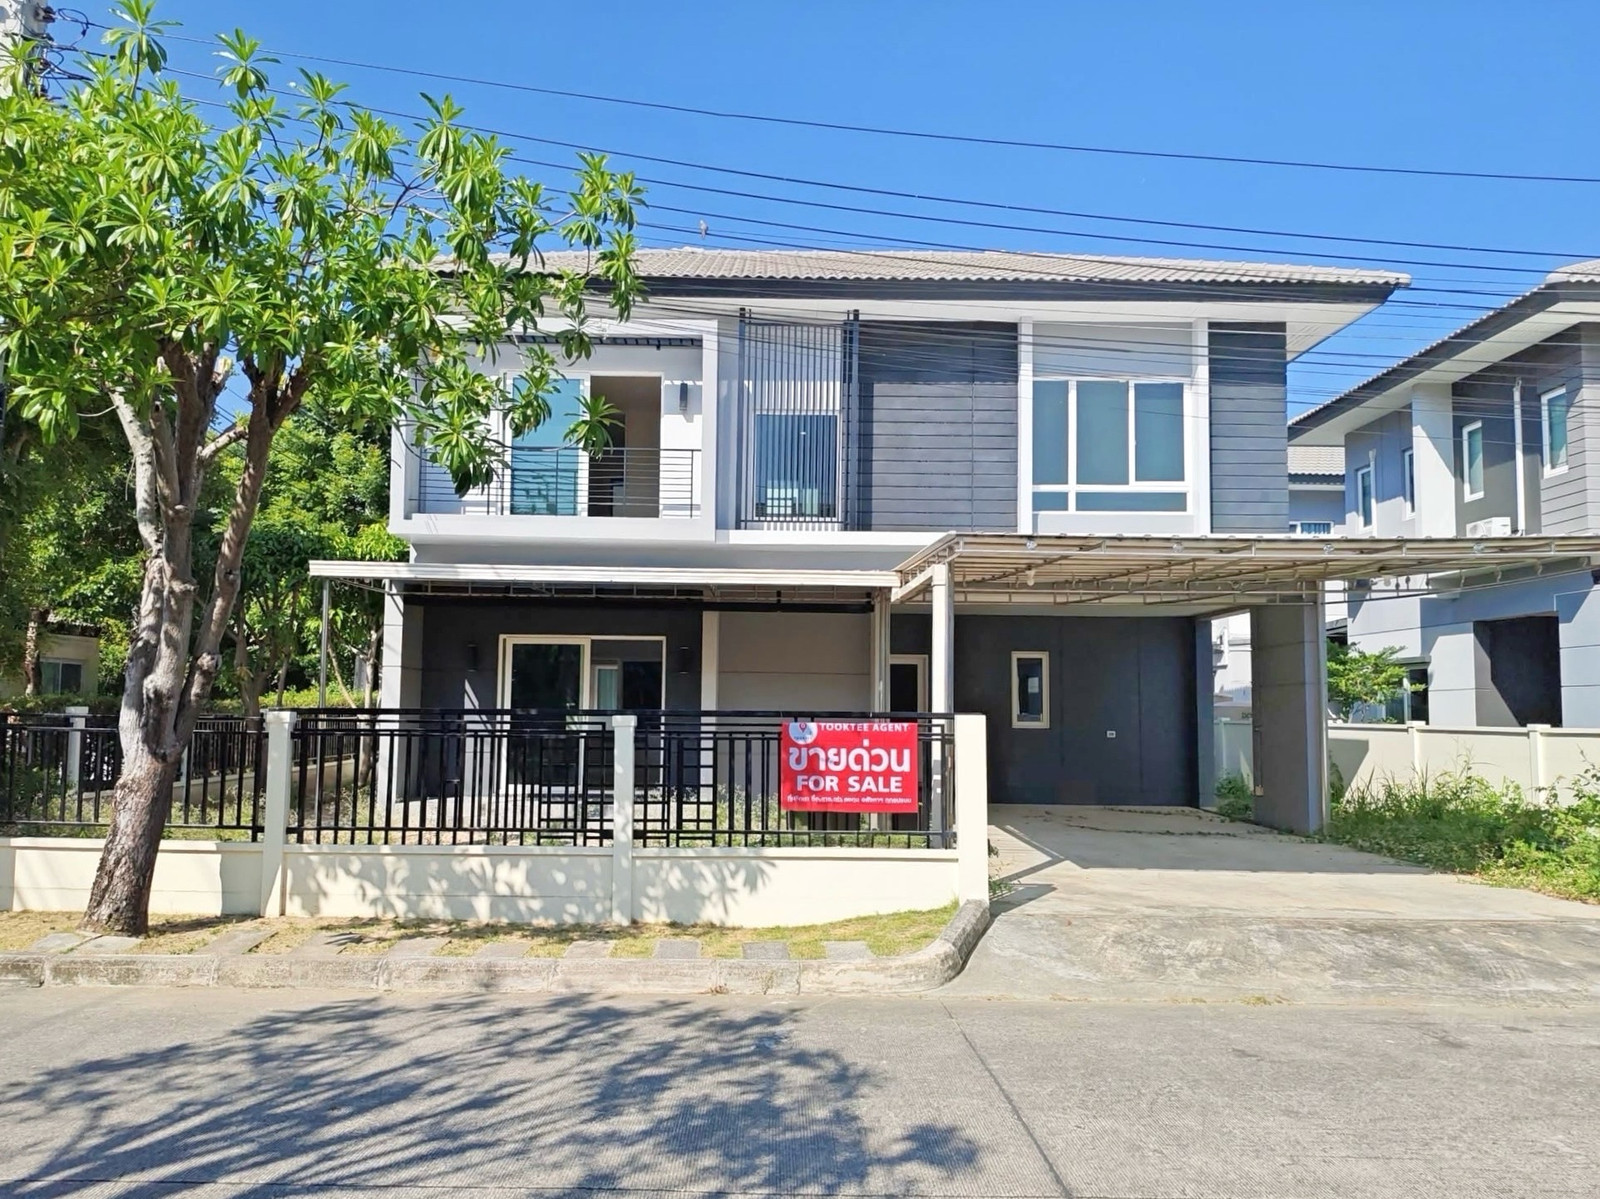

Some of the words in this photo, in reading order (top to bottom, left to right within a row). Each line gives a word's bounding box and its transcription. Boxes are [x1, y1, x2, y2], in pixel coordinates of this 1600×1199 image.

[819, 722, 869, 731] TOOKTEE
[872, 723, 909, 732] AGENT
[789, 739, 910, 772] ขายด่วน
[796, 775, 839, 791] FOR
[848, 776, 902, 792] SALE
